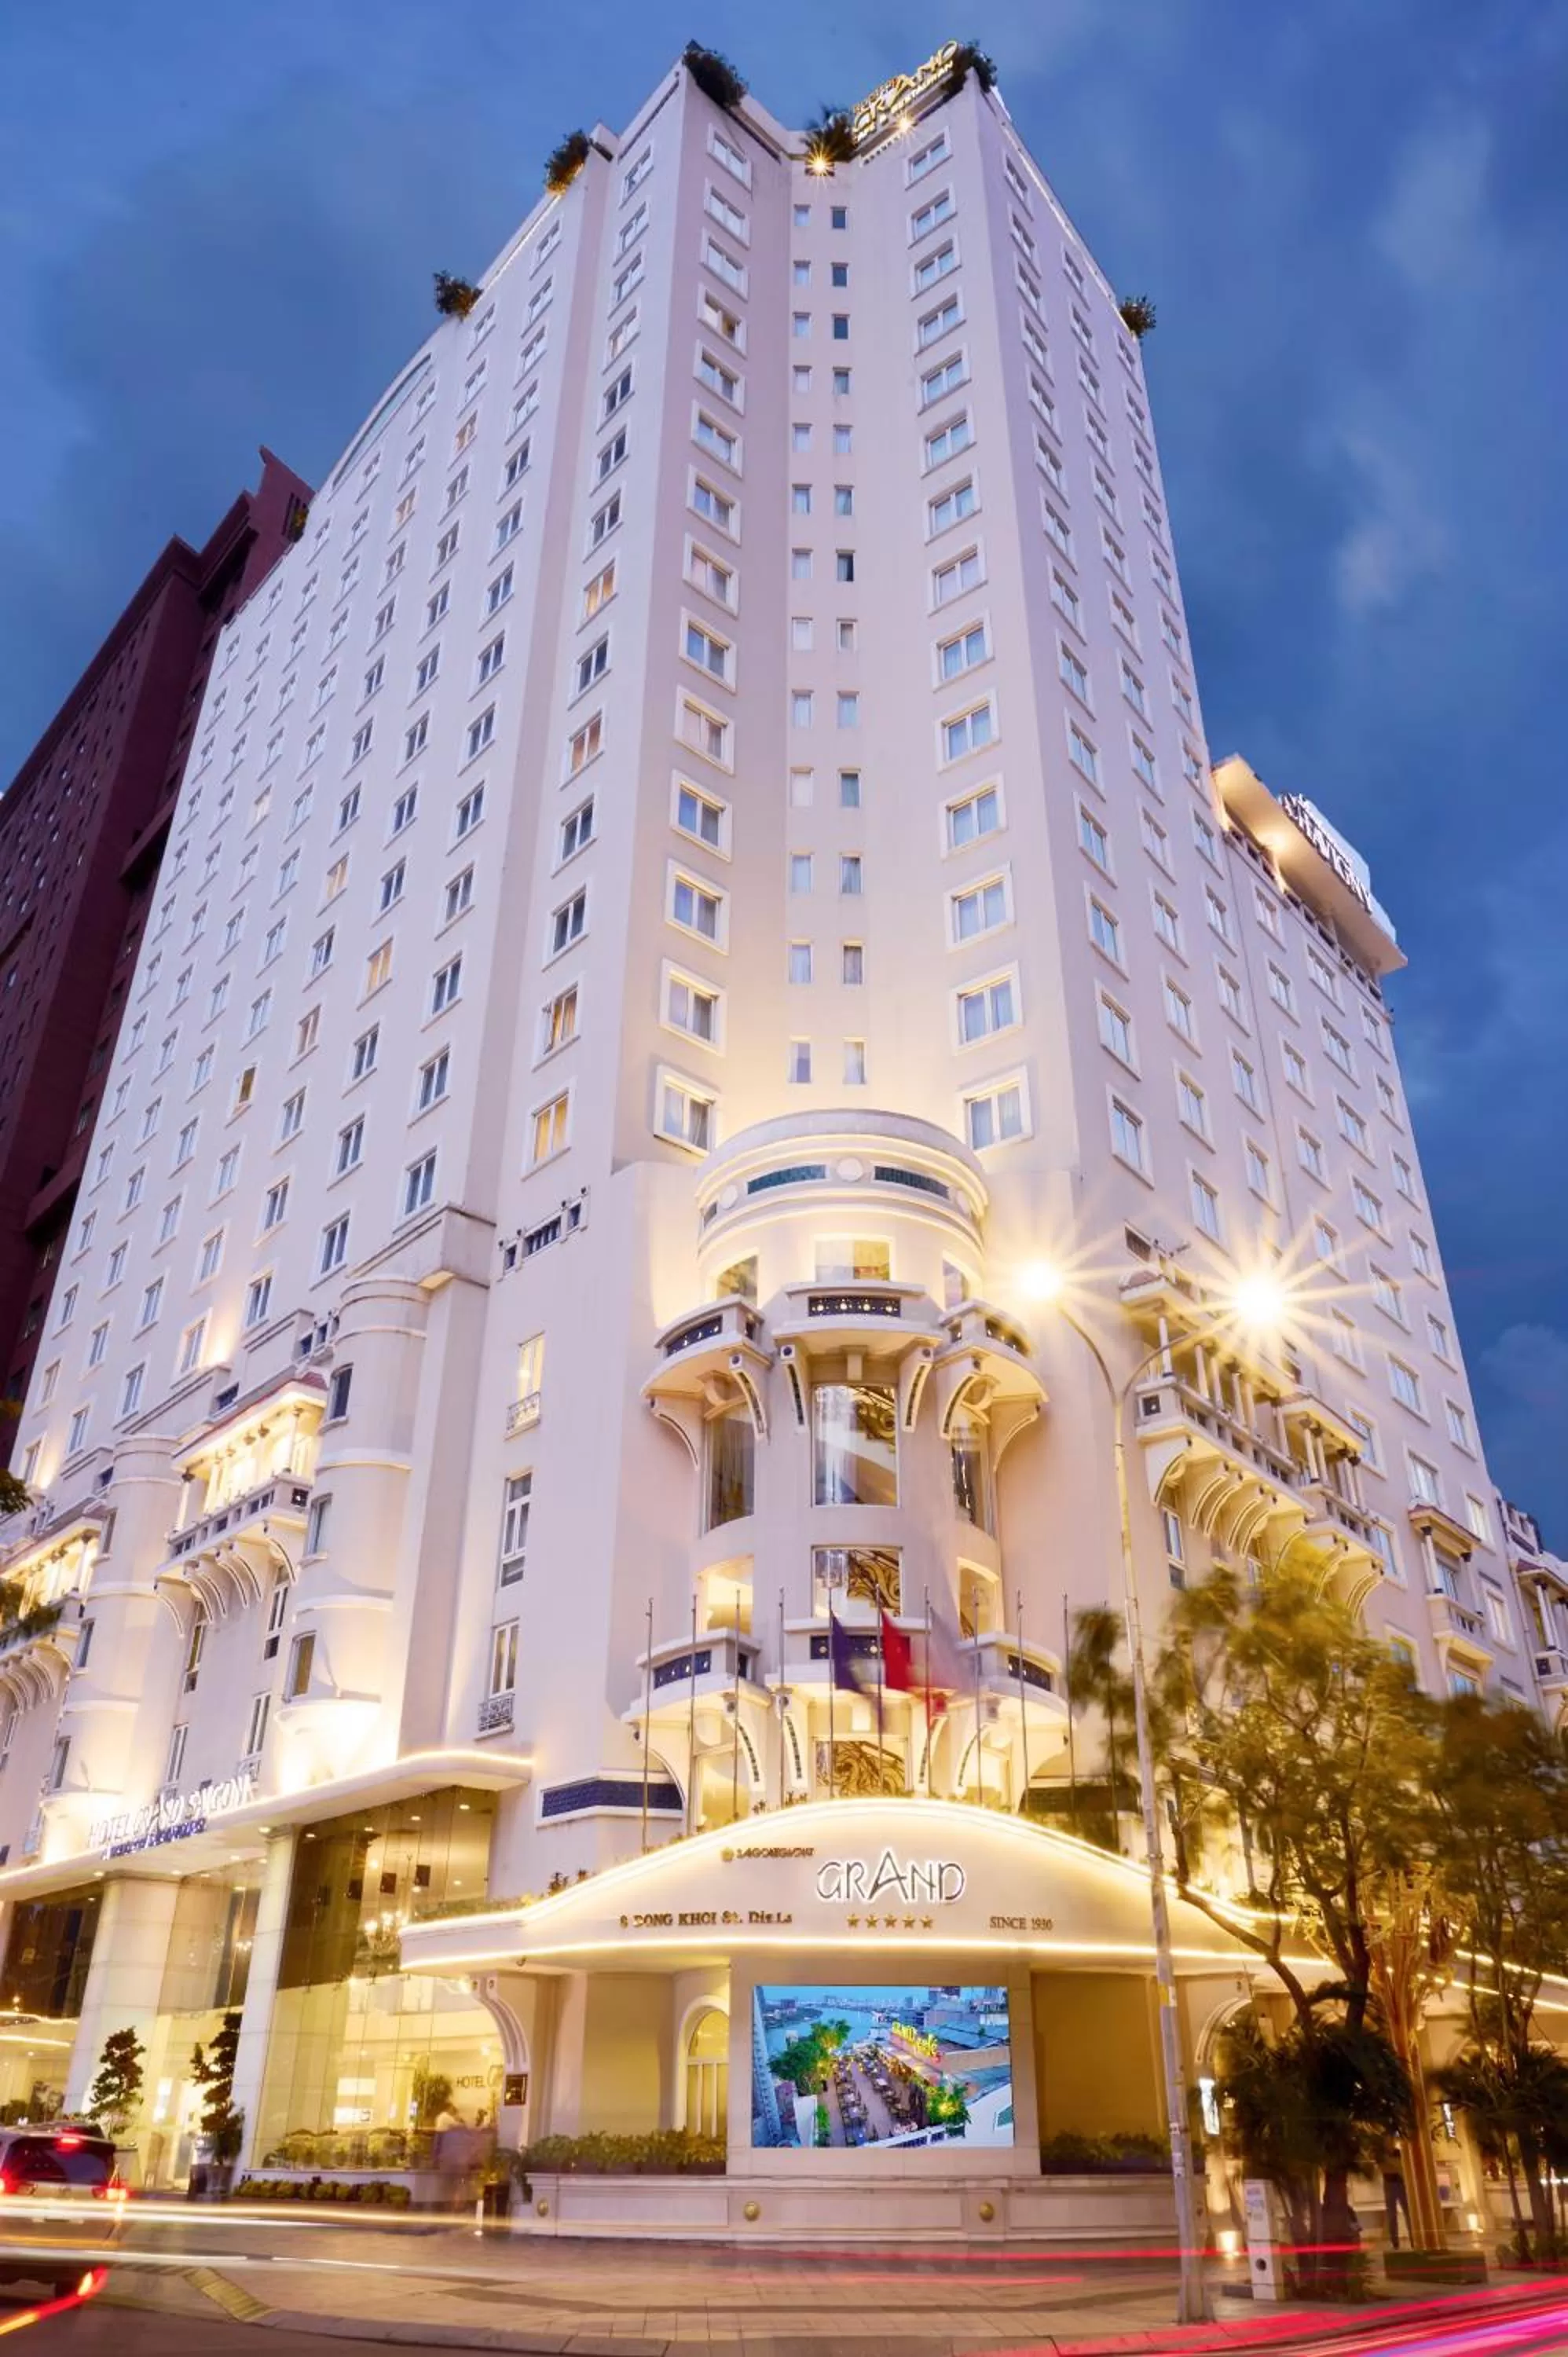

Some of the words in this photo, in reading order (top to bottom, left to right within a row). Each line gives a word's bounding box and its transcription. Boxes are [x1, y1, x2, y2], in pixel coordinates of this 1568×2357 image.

[816, 1846, 966, 1903] GRAND
[678, 1912, 717, 1925] KHOI
[990, 1916, 1026, 1930] SINCE
[456, 2075, 485, 2088] HOTEL
